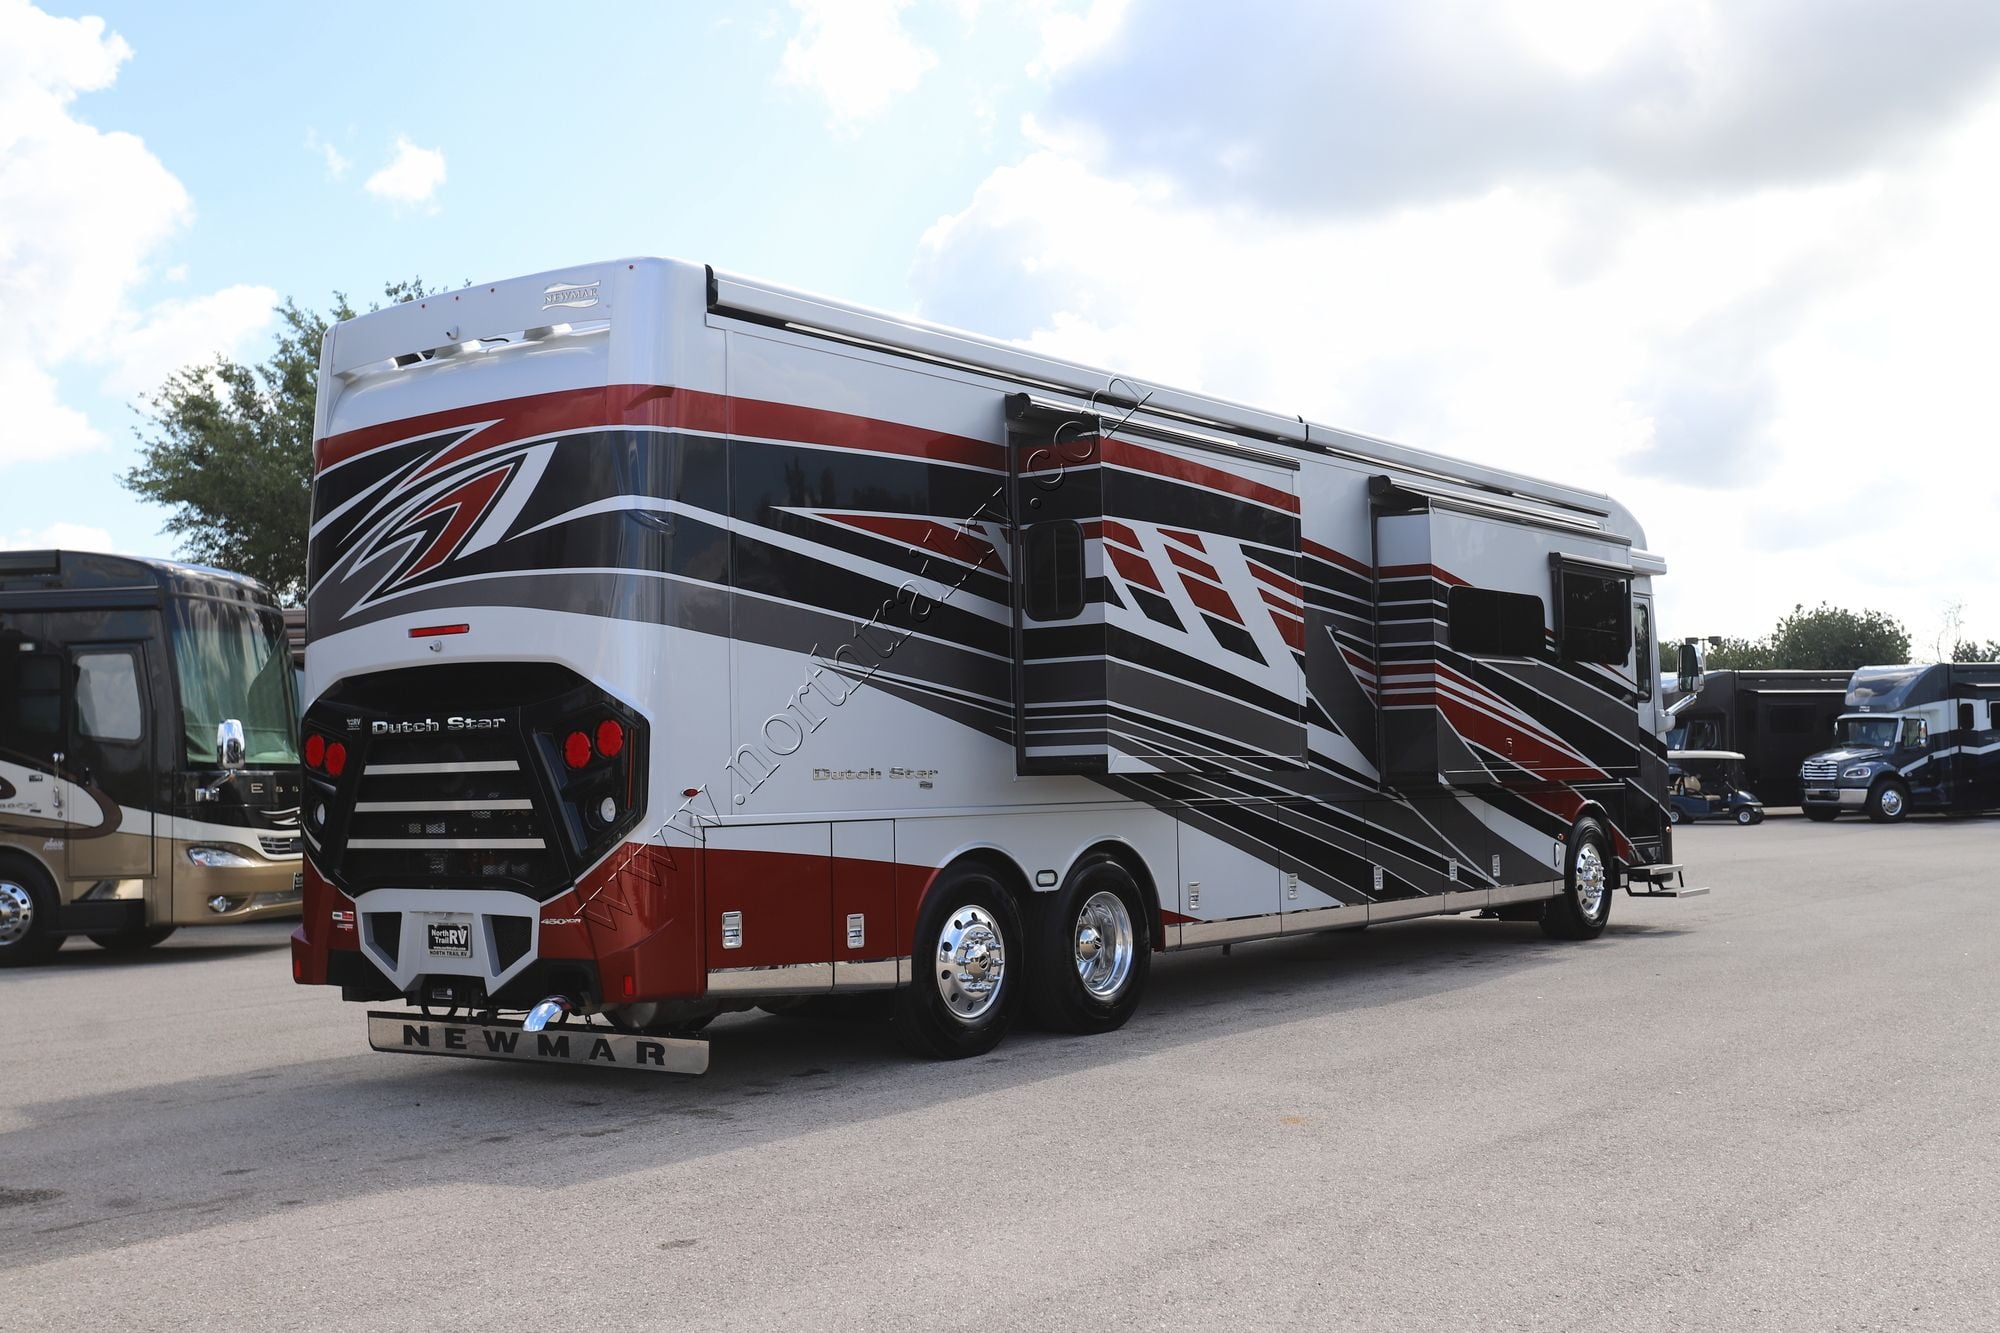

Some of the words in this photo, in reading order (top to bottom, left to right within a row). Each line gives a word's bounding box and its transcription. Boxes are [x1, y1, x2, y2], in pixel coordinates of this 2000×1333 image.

[545, 287, 599, 304] NEWMAR
[371, 717, 440, 735] Dutch
[447, 716, 506, 731] Star
[812, 767, 882, 781] Dutch
[888, 765, 939, 780] Star
[431, 928, 449, 937] North
[449, 928, 468, 945] RV
[434, 936, 450, 945] Trail
[402, 1024, 666, 1066] NEWMAR
